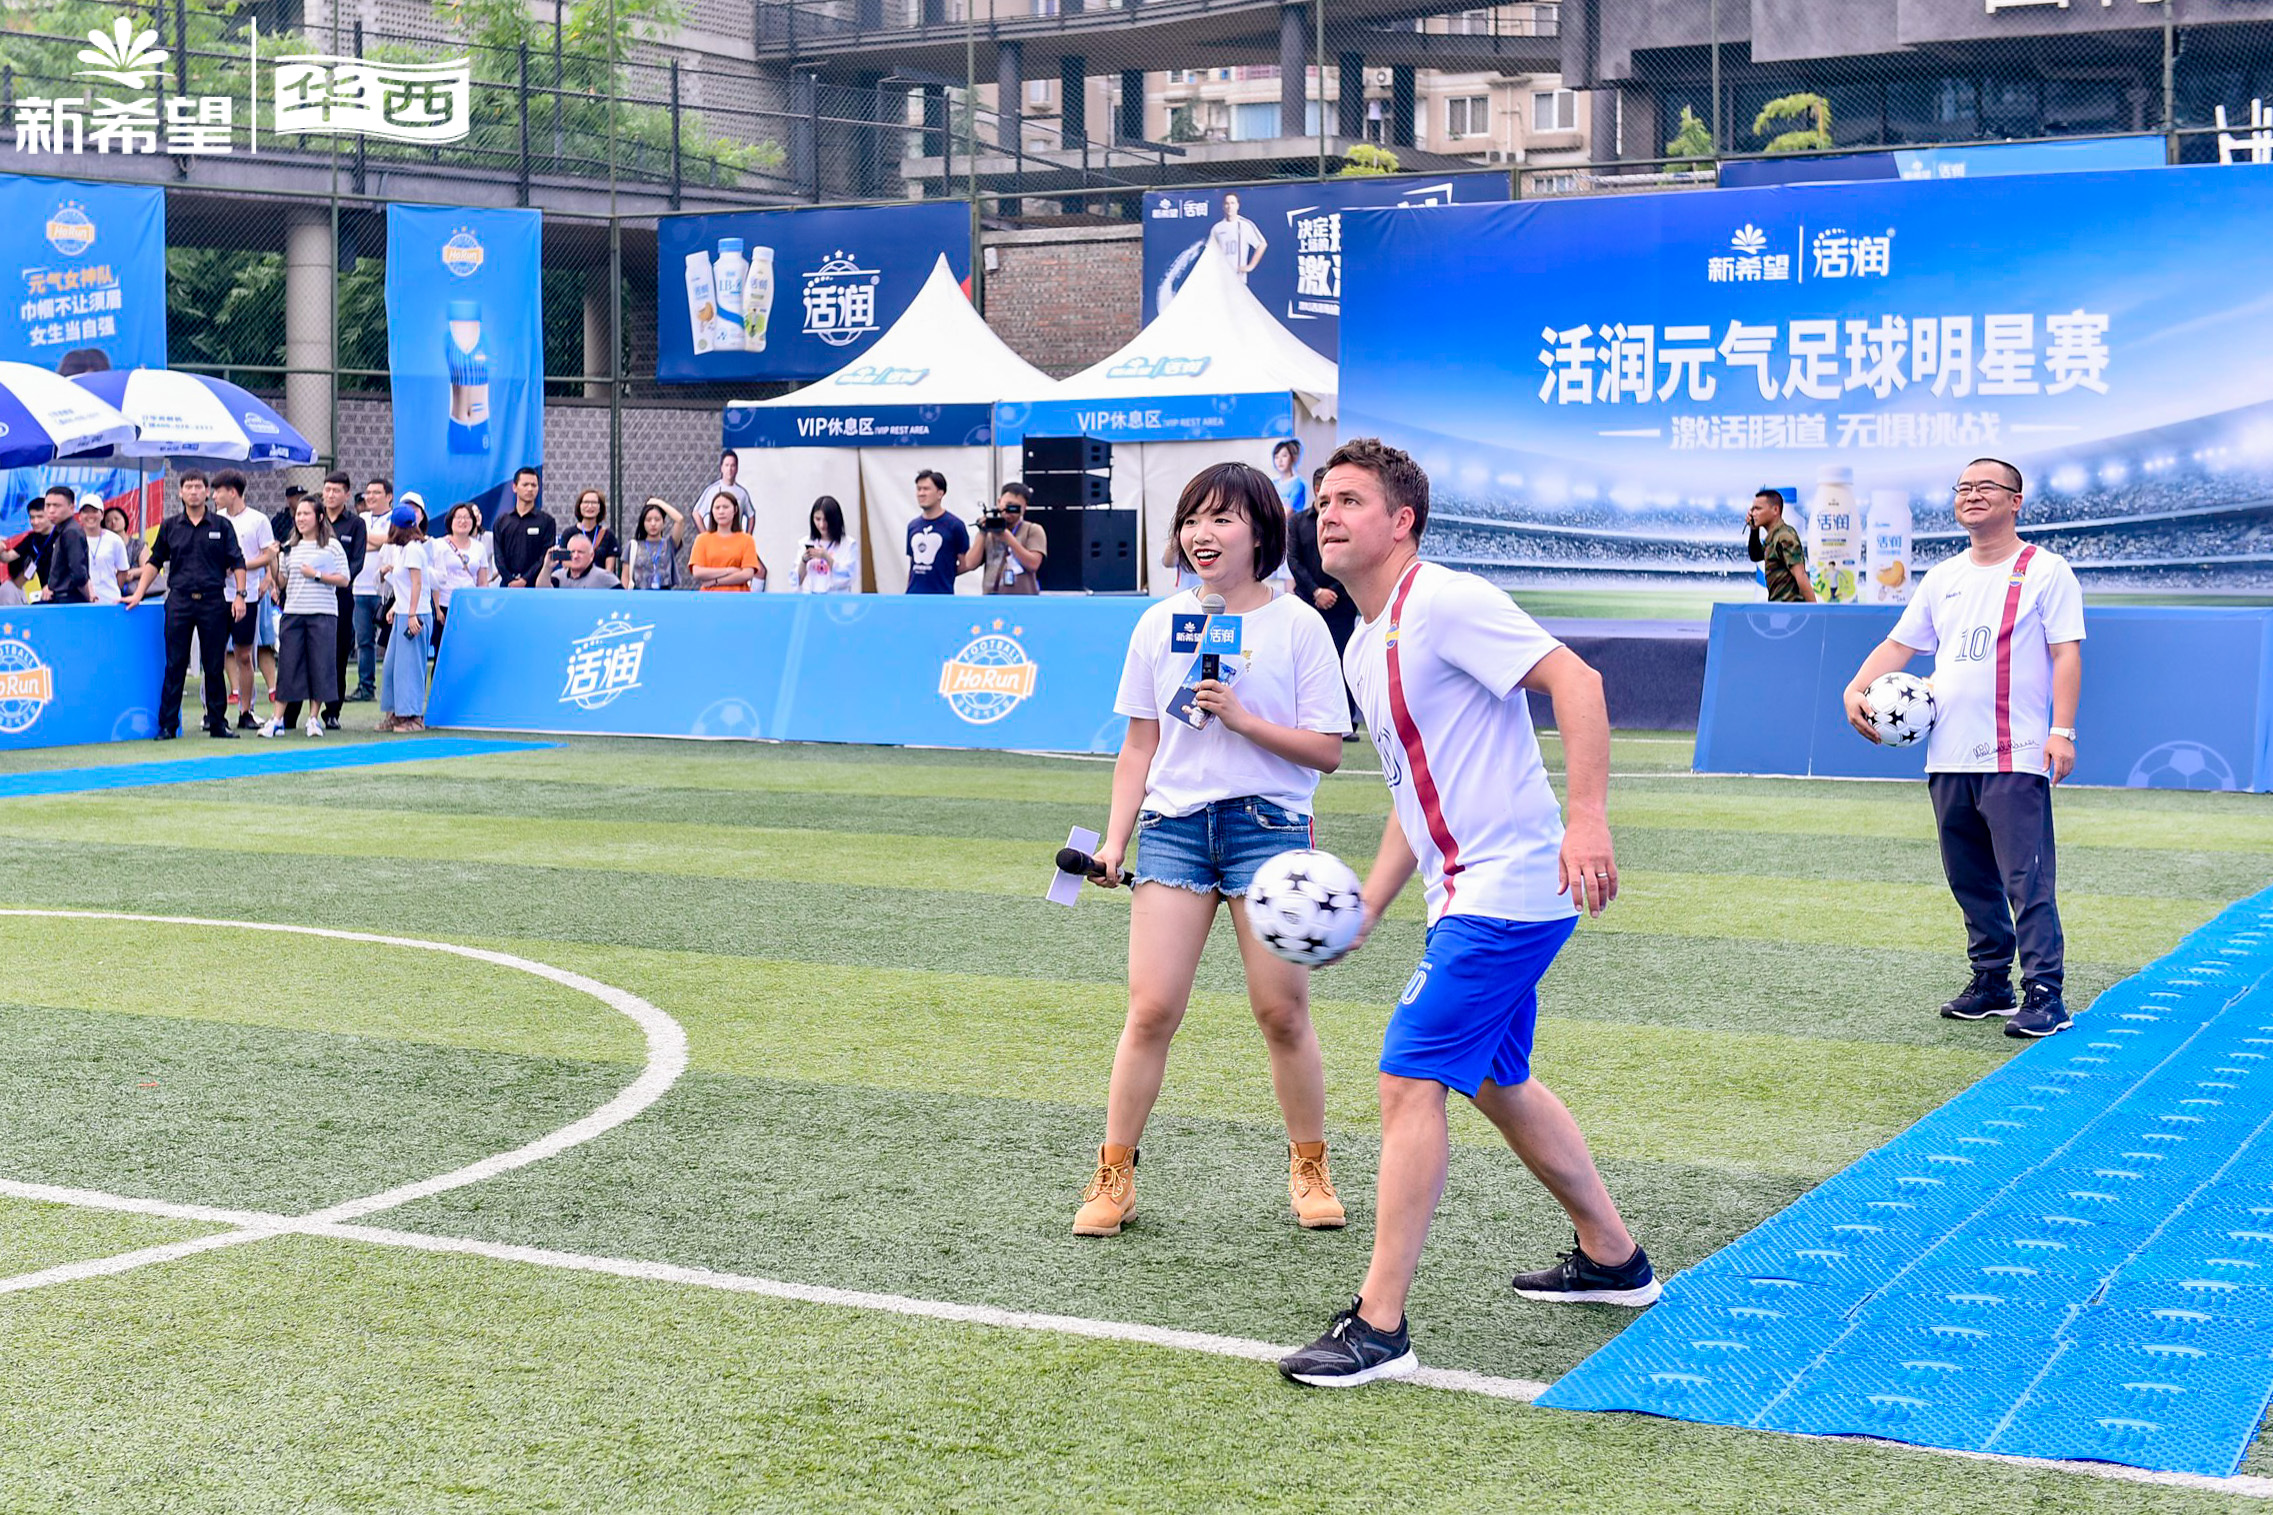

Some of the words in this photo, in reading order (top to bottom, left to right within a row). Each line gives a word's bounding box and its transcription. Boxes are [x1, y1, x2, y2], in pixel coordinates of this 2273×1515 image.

[1708, 255, 1789, 283] 新希望
[1813, 236, 1891, 278] 活润
[29, 265, 113, 294] 元气女神队
[21, 289, 121, 321] 巾帼不让须眉
[803, 283, 875, 329] 活润
[30, 315, 115, 346] 女生当自强
[1538, 309, 2110, 405] 活润元气足球明星赛
[797, 416, 875, 437] VIP休息区
[890, 426, 909, 435] REST
[909, 426, 930, 434] AREA
[1077, 410, 1162, 431] VIP休息区
[1203, 417, 1225, 426] AREA
[1669, 413, 1826, 449] 激活肠道
[1836, 412, 2001, 448] 无惧挑战
[963, 640, 1020, 662] FOOTBALL
[1210, 628, 1235, 643] 活润
[1955, 626, 1991, 661] 10
[562, 641, 645, 697] 活润
[952, 668, 1020, 690] HoRun
[0, 675, 40, 695] oRun
